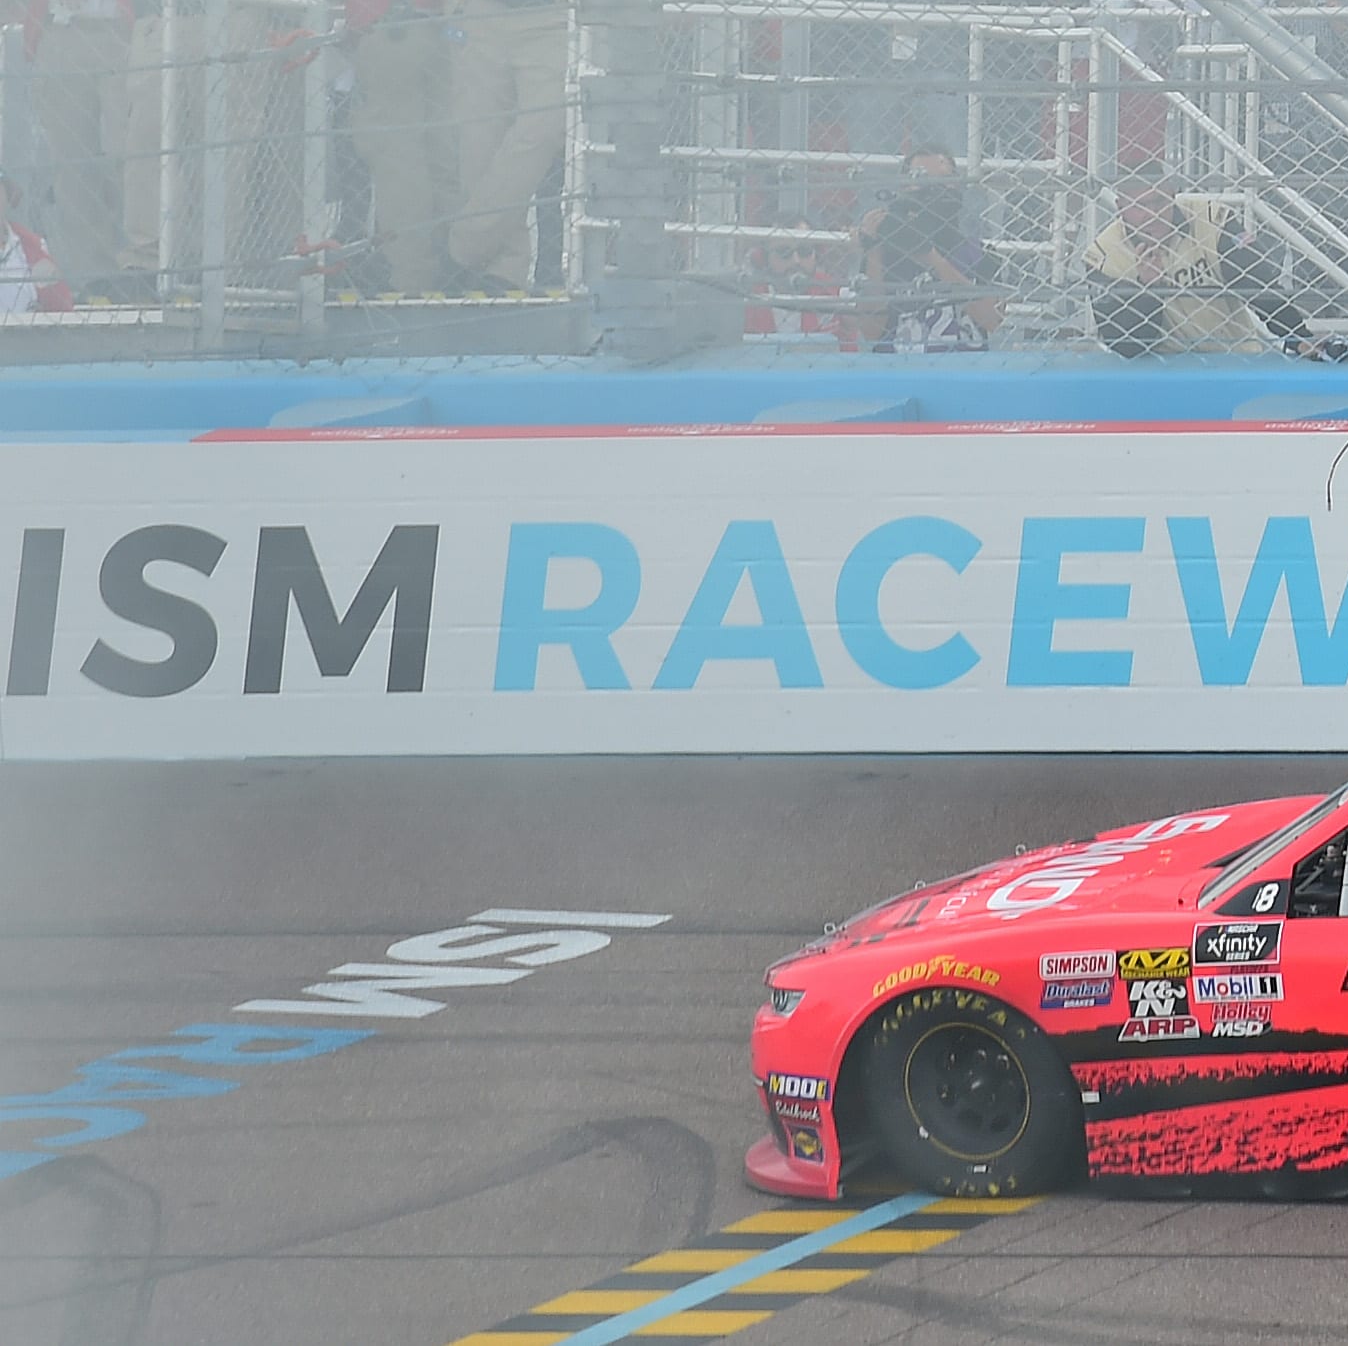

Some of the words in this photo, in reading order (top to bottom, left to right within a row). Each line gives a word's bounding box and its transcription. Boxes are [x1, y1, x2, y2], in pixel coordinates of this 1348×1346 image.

[5, 523, 441, 698] ISM
[1206, 933, 1268, 958] xfinity
[872, 954, 1001, 989] GOODYEAR
[1046, 955, 1108, 975] SIMPSON
[1198, 977, 1254, 996] Mobil
[1211, 1003, 1272, 1023] Holley
[1123, 1018, 1196, 1038] ARP
[1212, 1021, 1264, 1038] MSD
